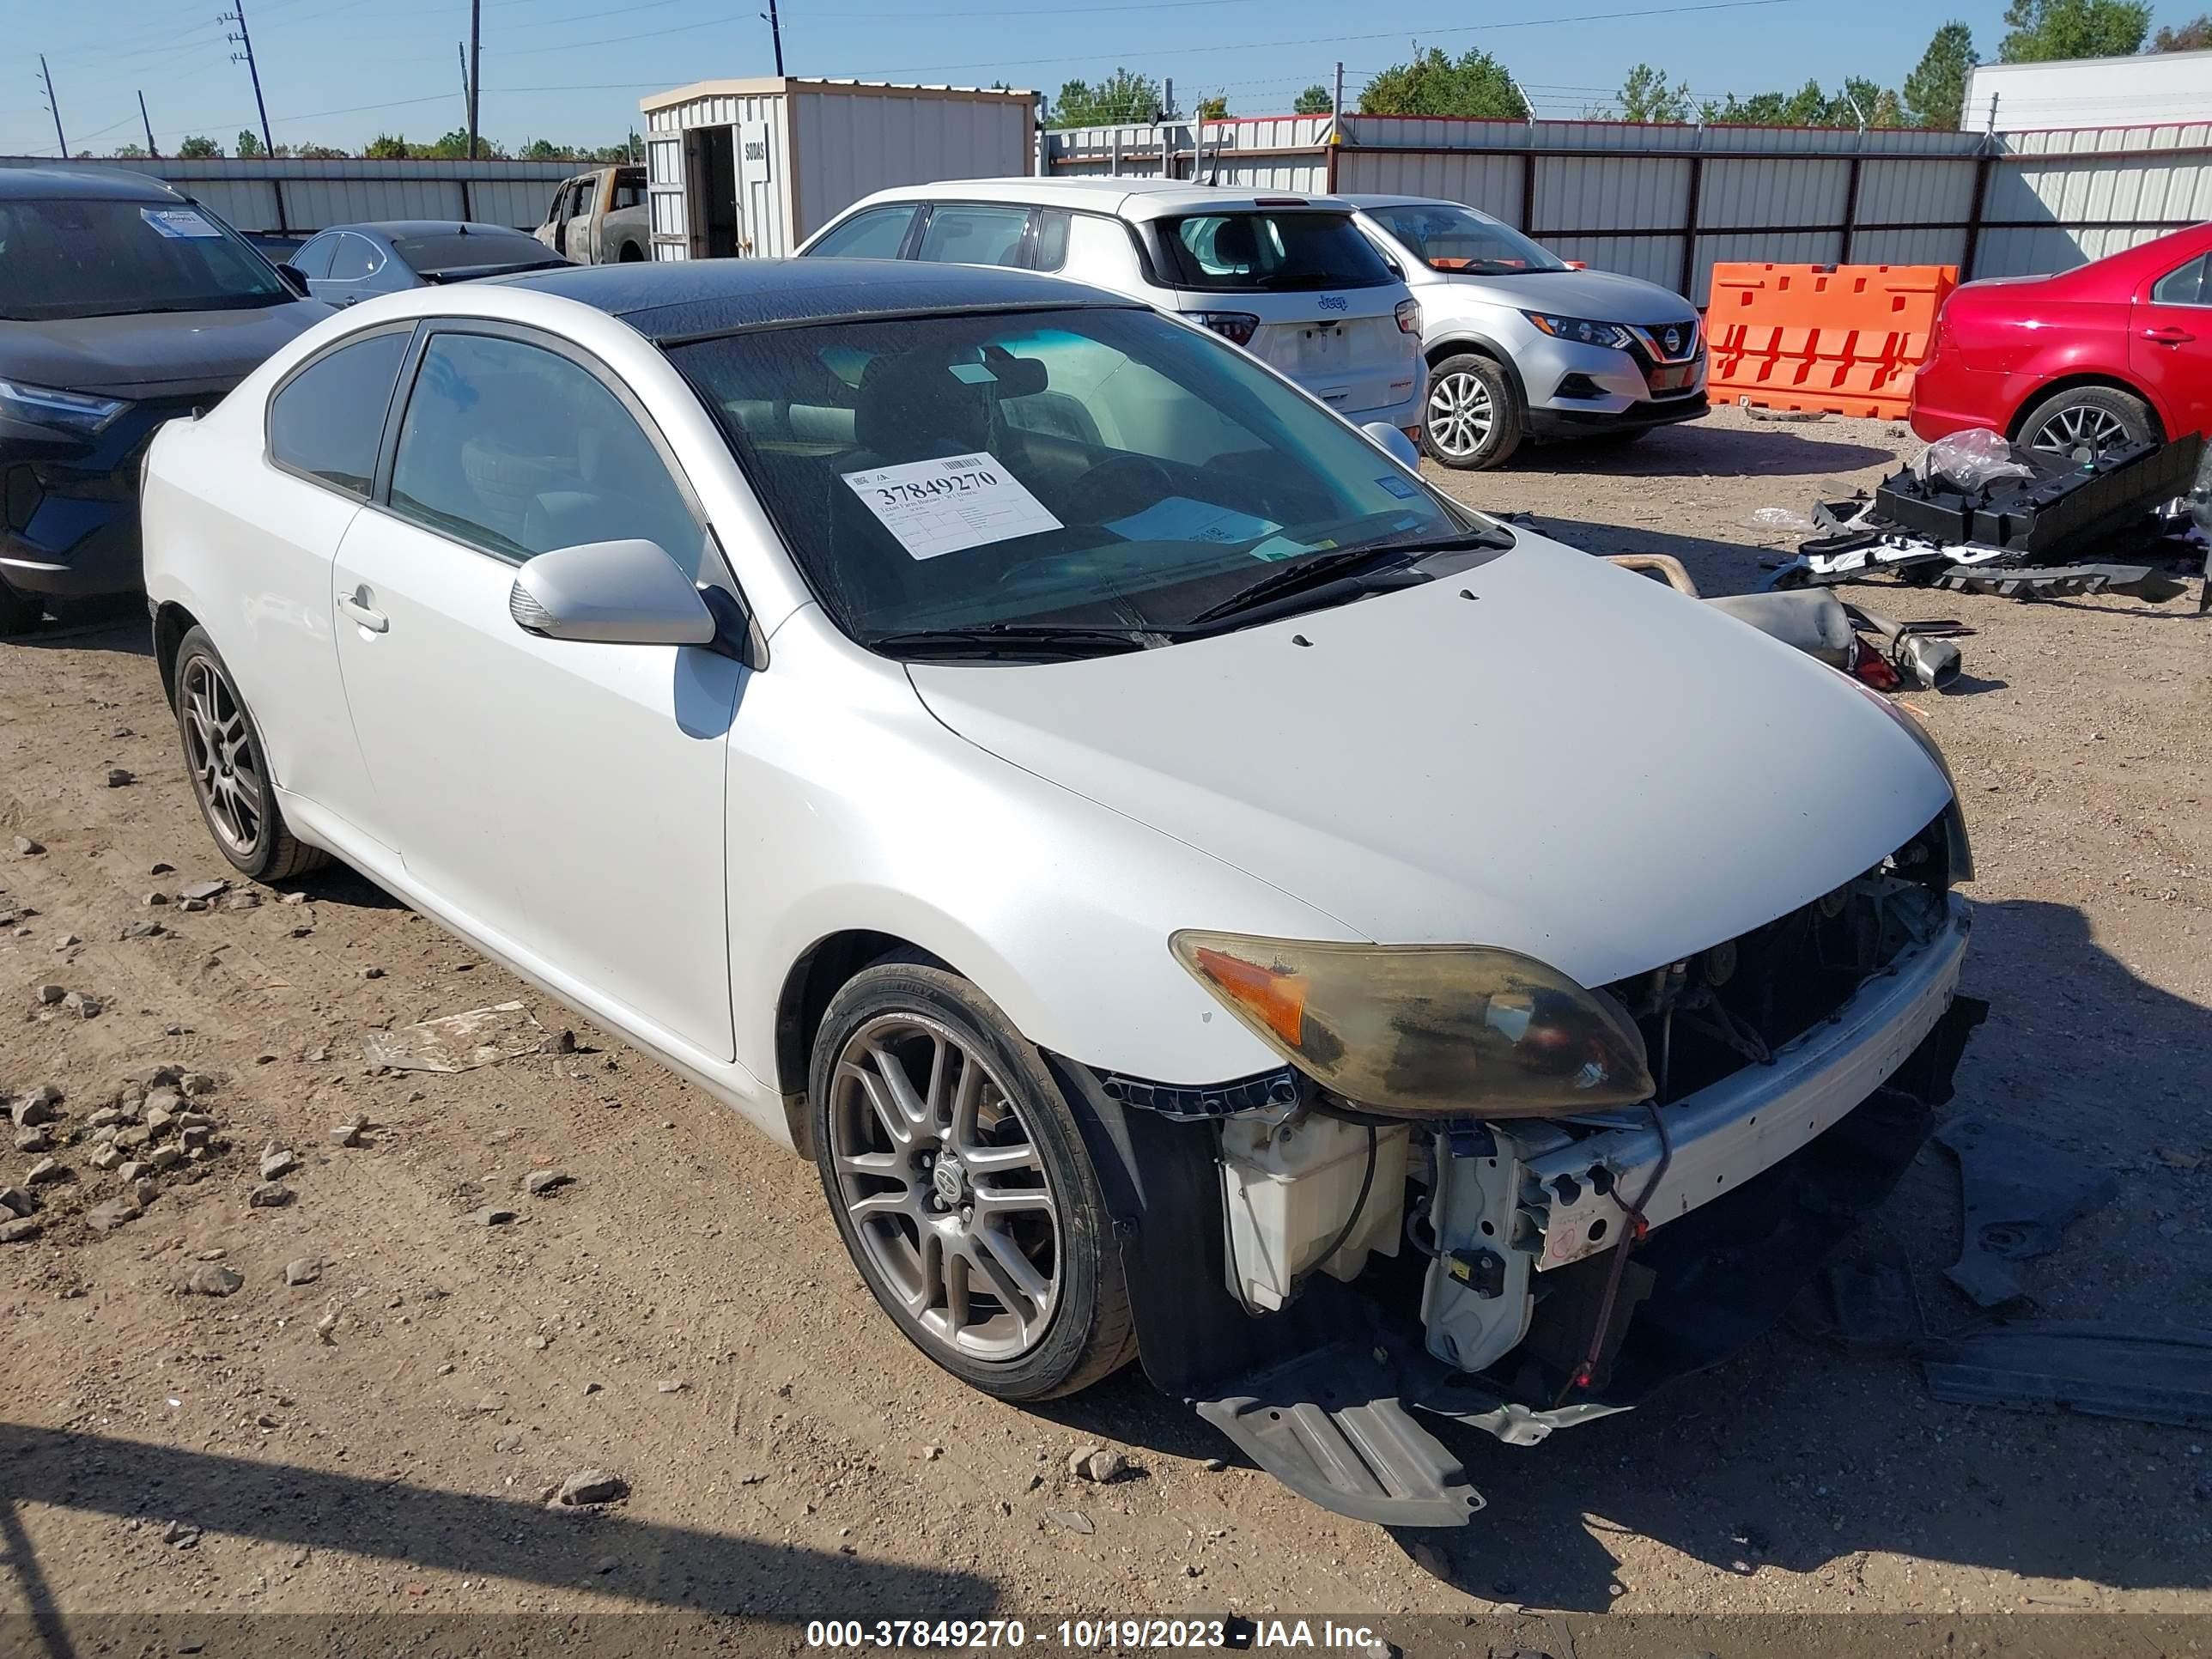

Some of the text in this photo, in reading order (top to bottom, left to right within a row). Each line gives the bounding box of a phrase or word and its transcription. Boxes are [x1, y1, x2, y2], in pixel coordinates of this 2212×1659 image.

[744, 142, 764, 161] SODAS
[1318, 295, 1349, 311] Jeep
[877, 471, 998, 506] 37849270
[879, 505, 900, 514] Texas
